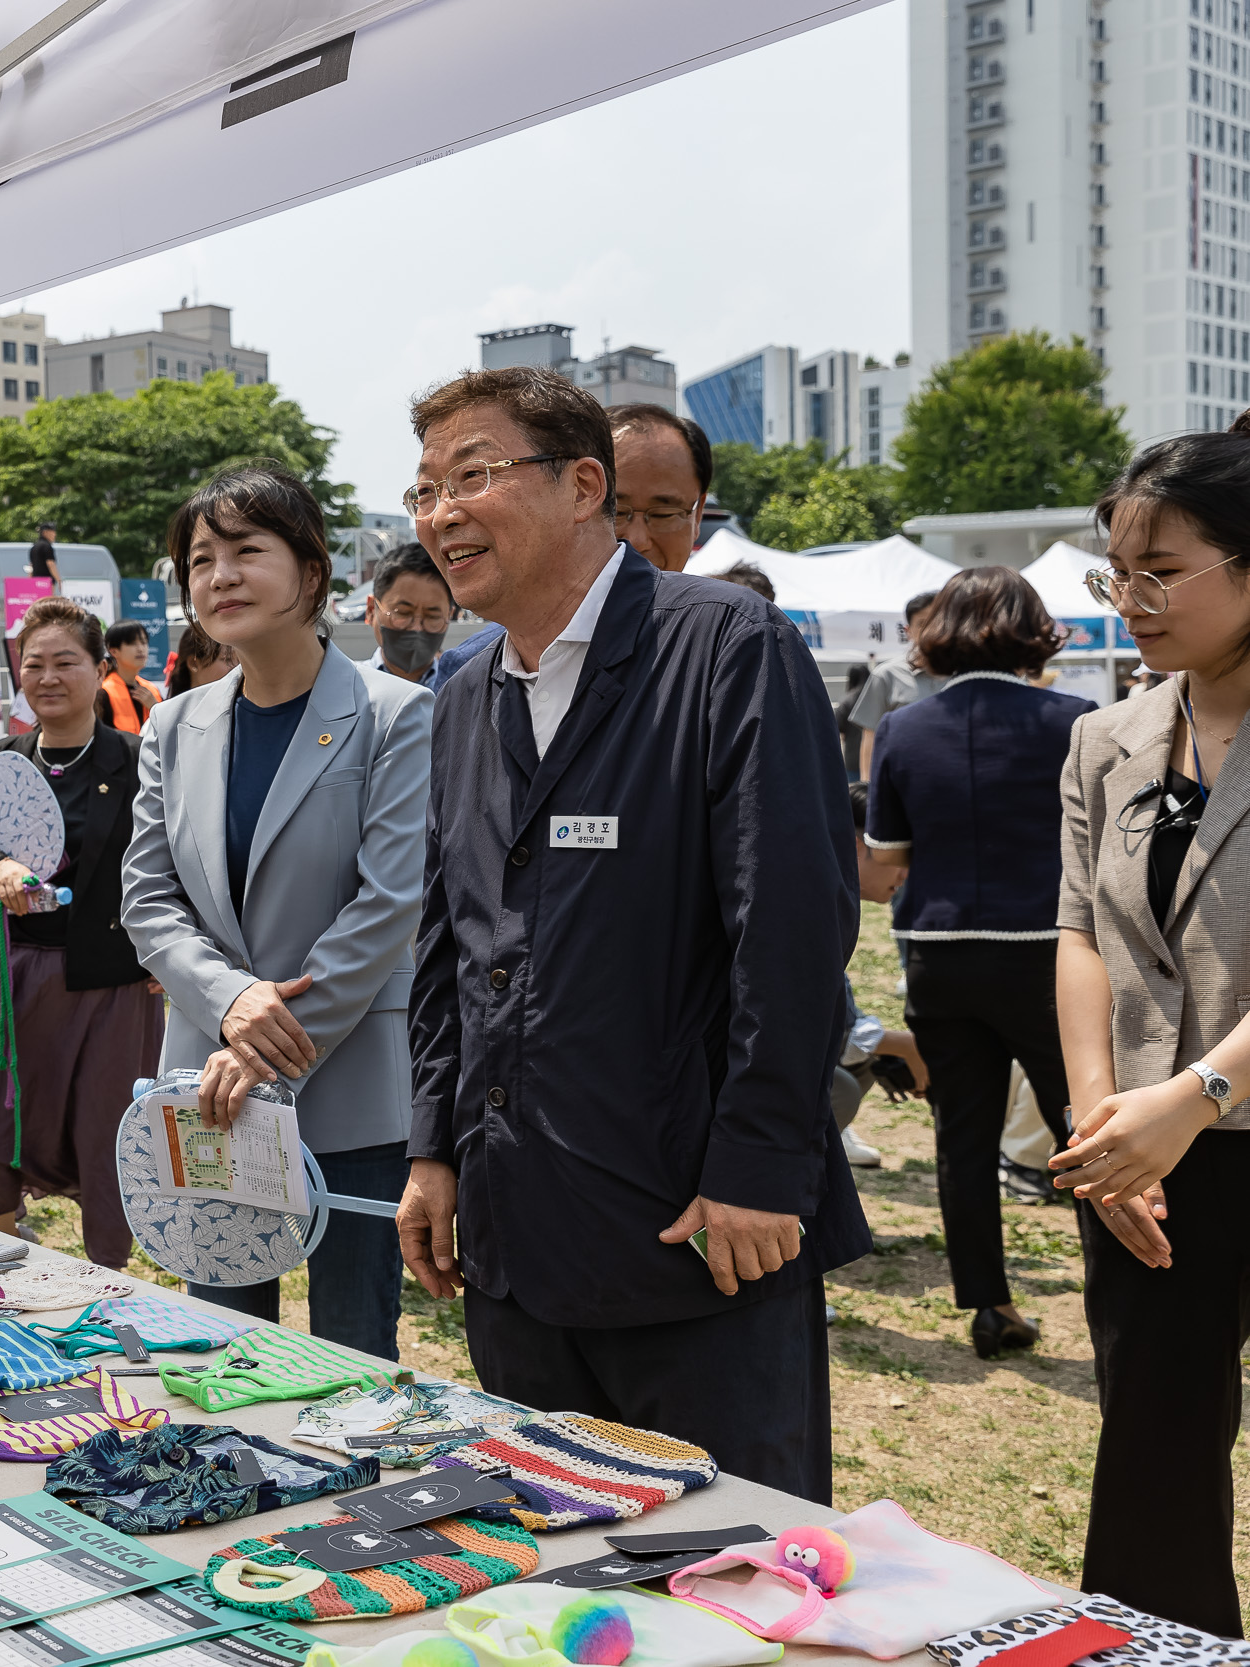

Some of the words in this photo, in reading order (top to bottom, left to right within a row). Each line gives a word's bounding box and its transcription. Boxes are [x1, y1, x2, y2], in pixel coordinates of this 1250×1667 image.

[35, 1509, 88, 1534] SIZE
[79, 1531, 158, 1569] CHECK
[171, 1578, 225, 1612] HECK
[251, 1626, 312, 1654] HECK
